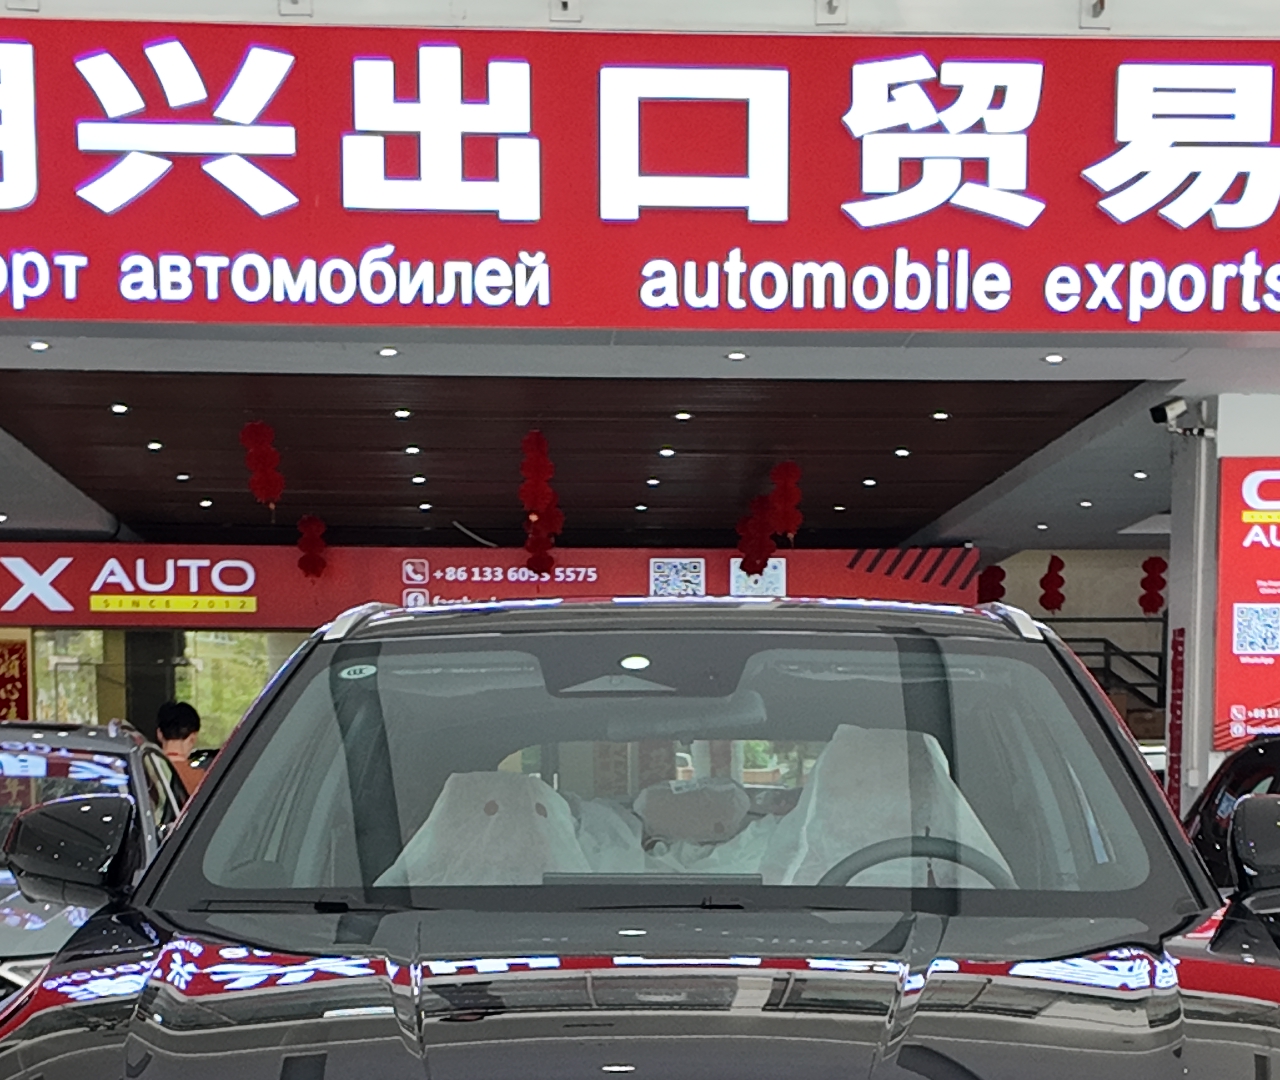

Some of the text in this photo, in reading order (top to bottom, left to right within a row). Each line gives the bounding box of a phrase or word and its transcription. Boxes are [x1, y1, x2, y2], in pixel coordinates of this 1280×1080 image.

[120, 244, 551, 307] автомобилей
[639, 248, 1012, 311] automobile
[90, 558, 256, 593] AUTO
[433, 566, 468, 581] +86
[471, 567, 504, 581] 133
[555, 567, 598, 581] 5575
